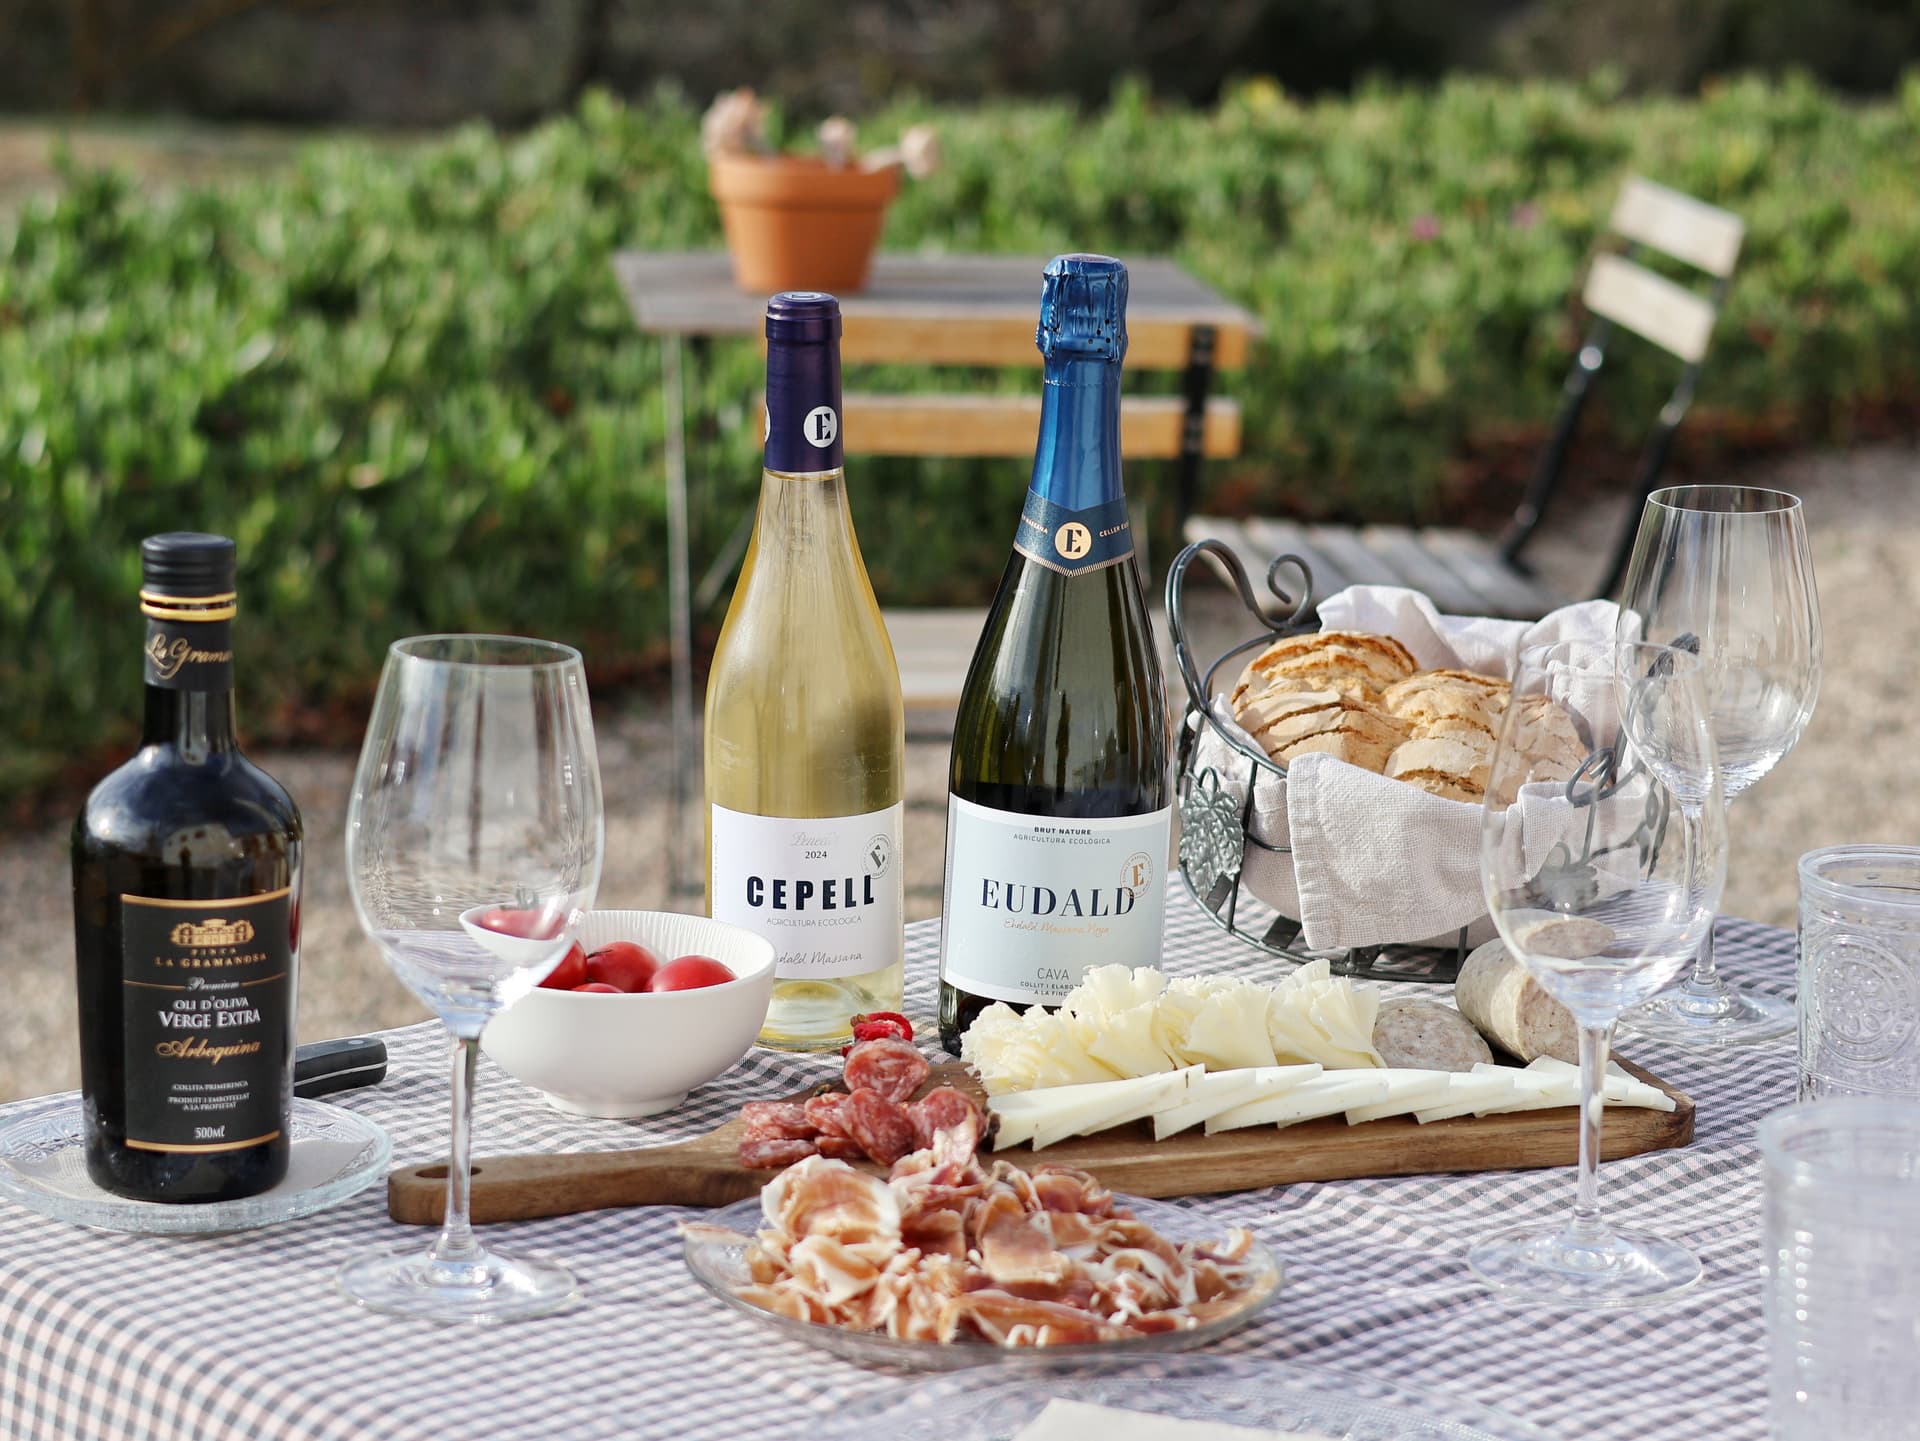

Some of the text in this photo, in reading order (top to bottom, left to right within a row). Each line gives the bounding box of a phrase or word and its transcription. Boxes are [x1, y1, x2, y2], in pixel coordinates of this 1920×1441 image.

[1099, 525, 1120, 537] CELLER
[1065, 529, 1081, 552] E
[1034, 826, 1092, 836] BRUT NATURE
[1013, 833, 1066, 844] AGRICULTURA
[805, 850, 827, 859] 2024
[747, 874, 874, 911] CEPELL
[981, 877, 1135, 917] EUDALD
[767, 917, 816, 927] AGRICULTURA
[154, 956, 174, 967] LA
[1037, 967, 1070, 980] CAVA
[186, 977, 240, 992] Premium
[1020, 981, 1044, 989] COLLIT
[173, 995, 249, 1011] OLI D'OLIVA
[159, 1009, 261, 1028] VERGE EXTRA
[156, 1036, 261, 1066] Arbequina
